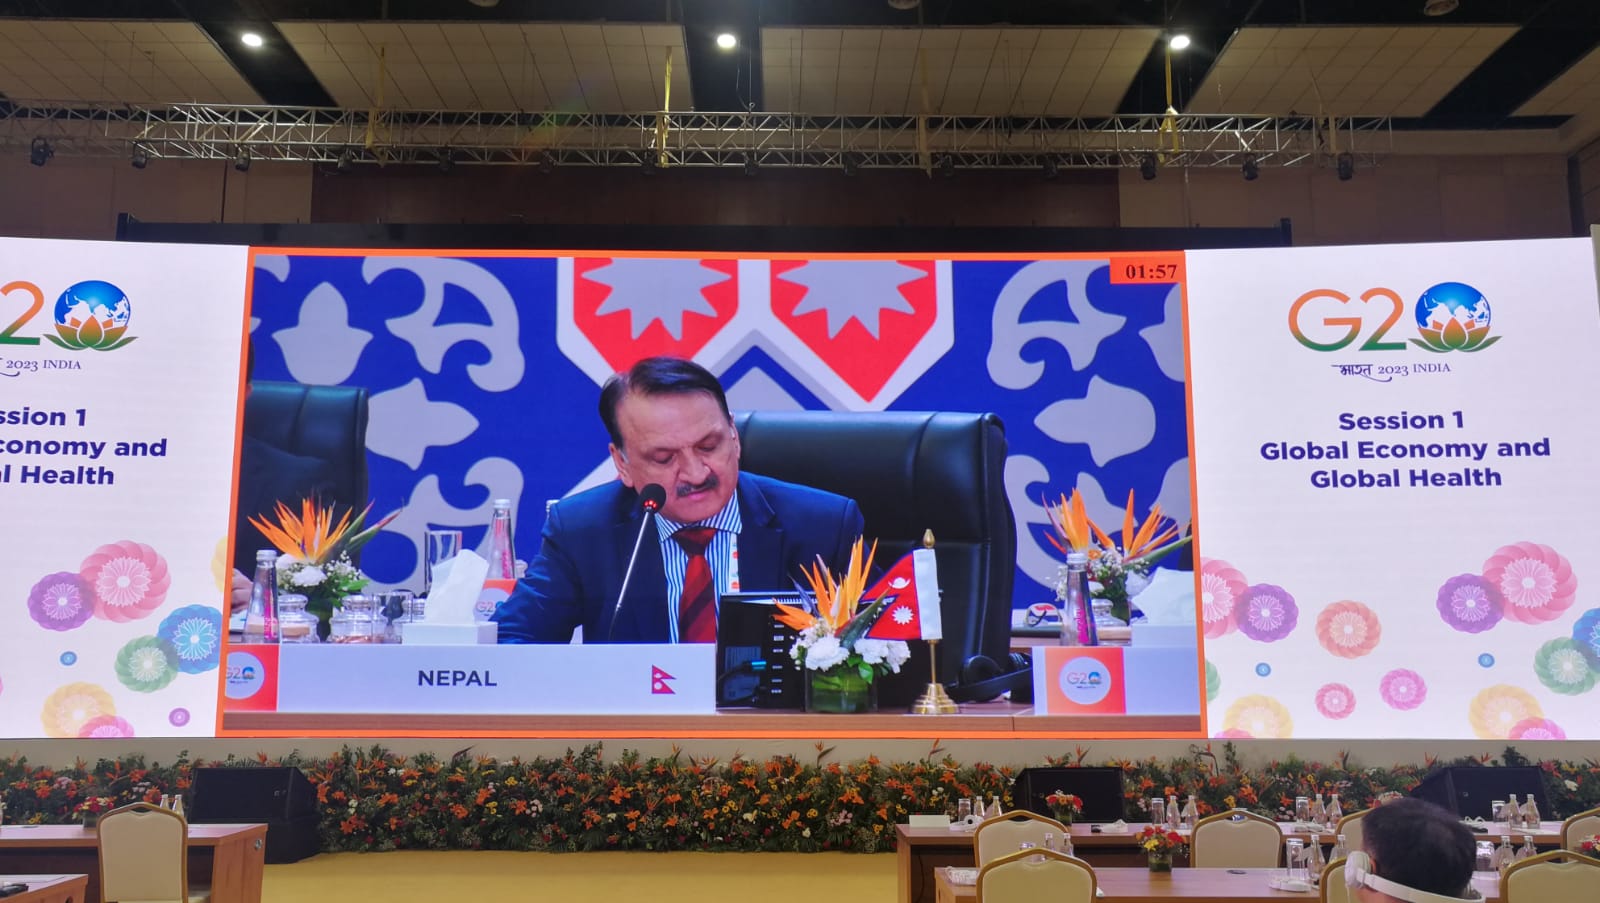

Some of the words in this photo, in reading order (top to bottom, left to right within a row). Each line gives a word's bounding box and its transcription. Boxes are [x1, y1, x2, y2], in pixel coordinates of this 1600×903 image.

[1126, 264, 1177, 279] 01:57
[6, 360, 38, 372] 2023
[43, 360, 81, 370] INDIA
[1378, 365, 1409, 376] 2023
[1413, 363, 1451, 373] INDIA
[76, 408, 87, 426] 1
[1338, 411, 1445, 430] Session
[1452, 411, 1464, 428] 1
[114, 438, 168, 456] and
[1260, 441, 1349, 460] Global
[1357, 440, 1488, 461] Economy
[1497, 438, 1551, 456] and
[20, 465, 115, 485] Health
[1310, 469, 1400, 488] Global
[1408, 467, 1502, 487] Health
[418, 670, 497, 686] NEPAL
